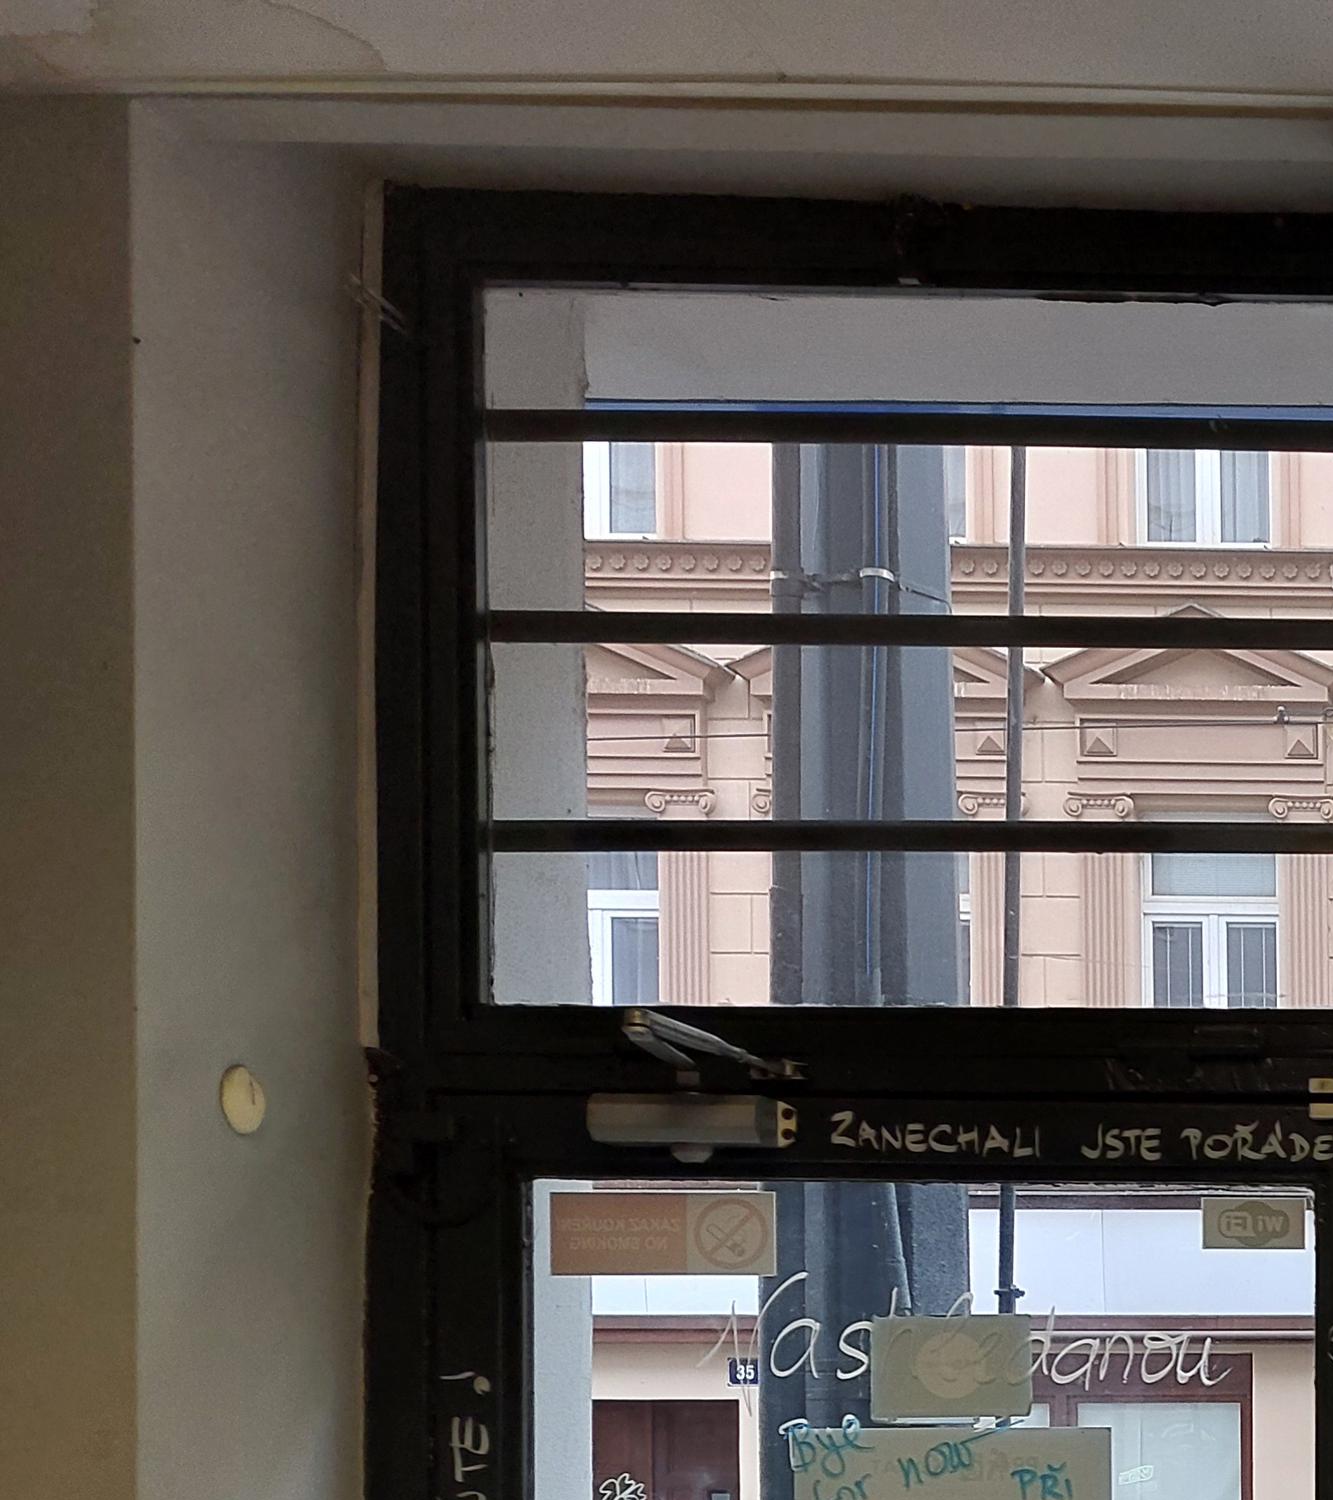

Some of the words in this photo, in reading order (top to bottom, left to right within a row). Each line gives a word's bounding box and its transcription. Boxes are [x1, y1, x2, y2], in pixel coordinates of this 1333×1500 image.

[829, 1109, 1041, 1160] ZANECHALI
[1081, 1121, 1163, 1162] JSTE
[736, 1364, 756, 1381] 35
